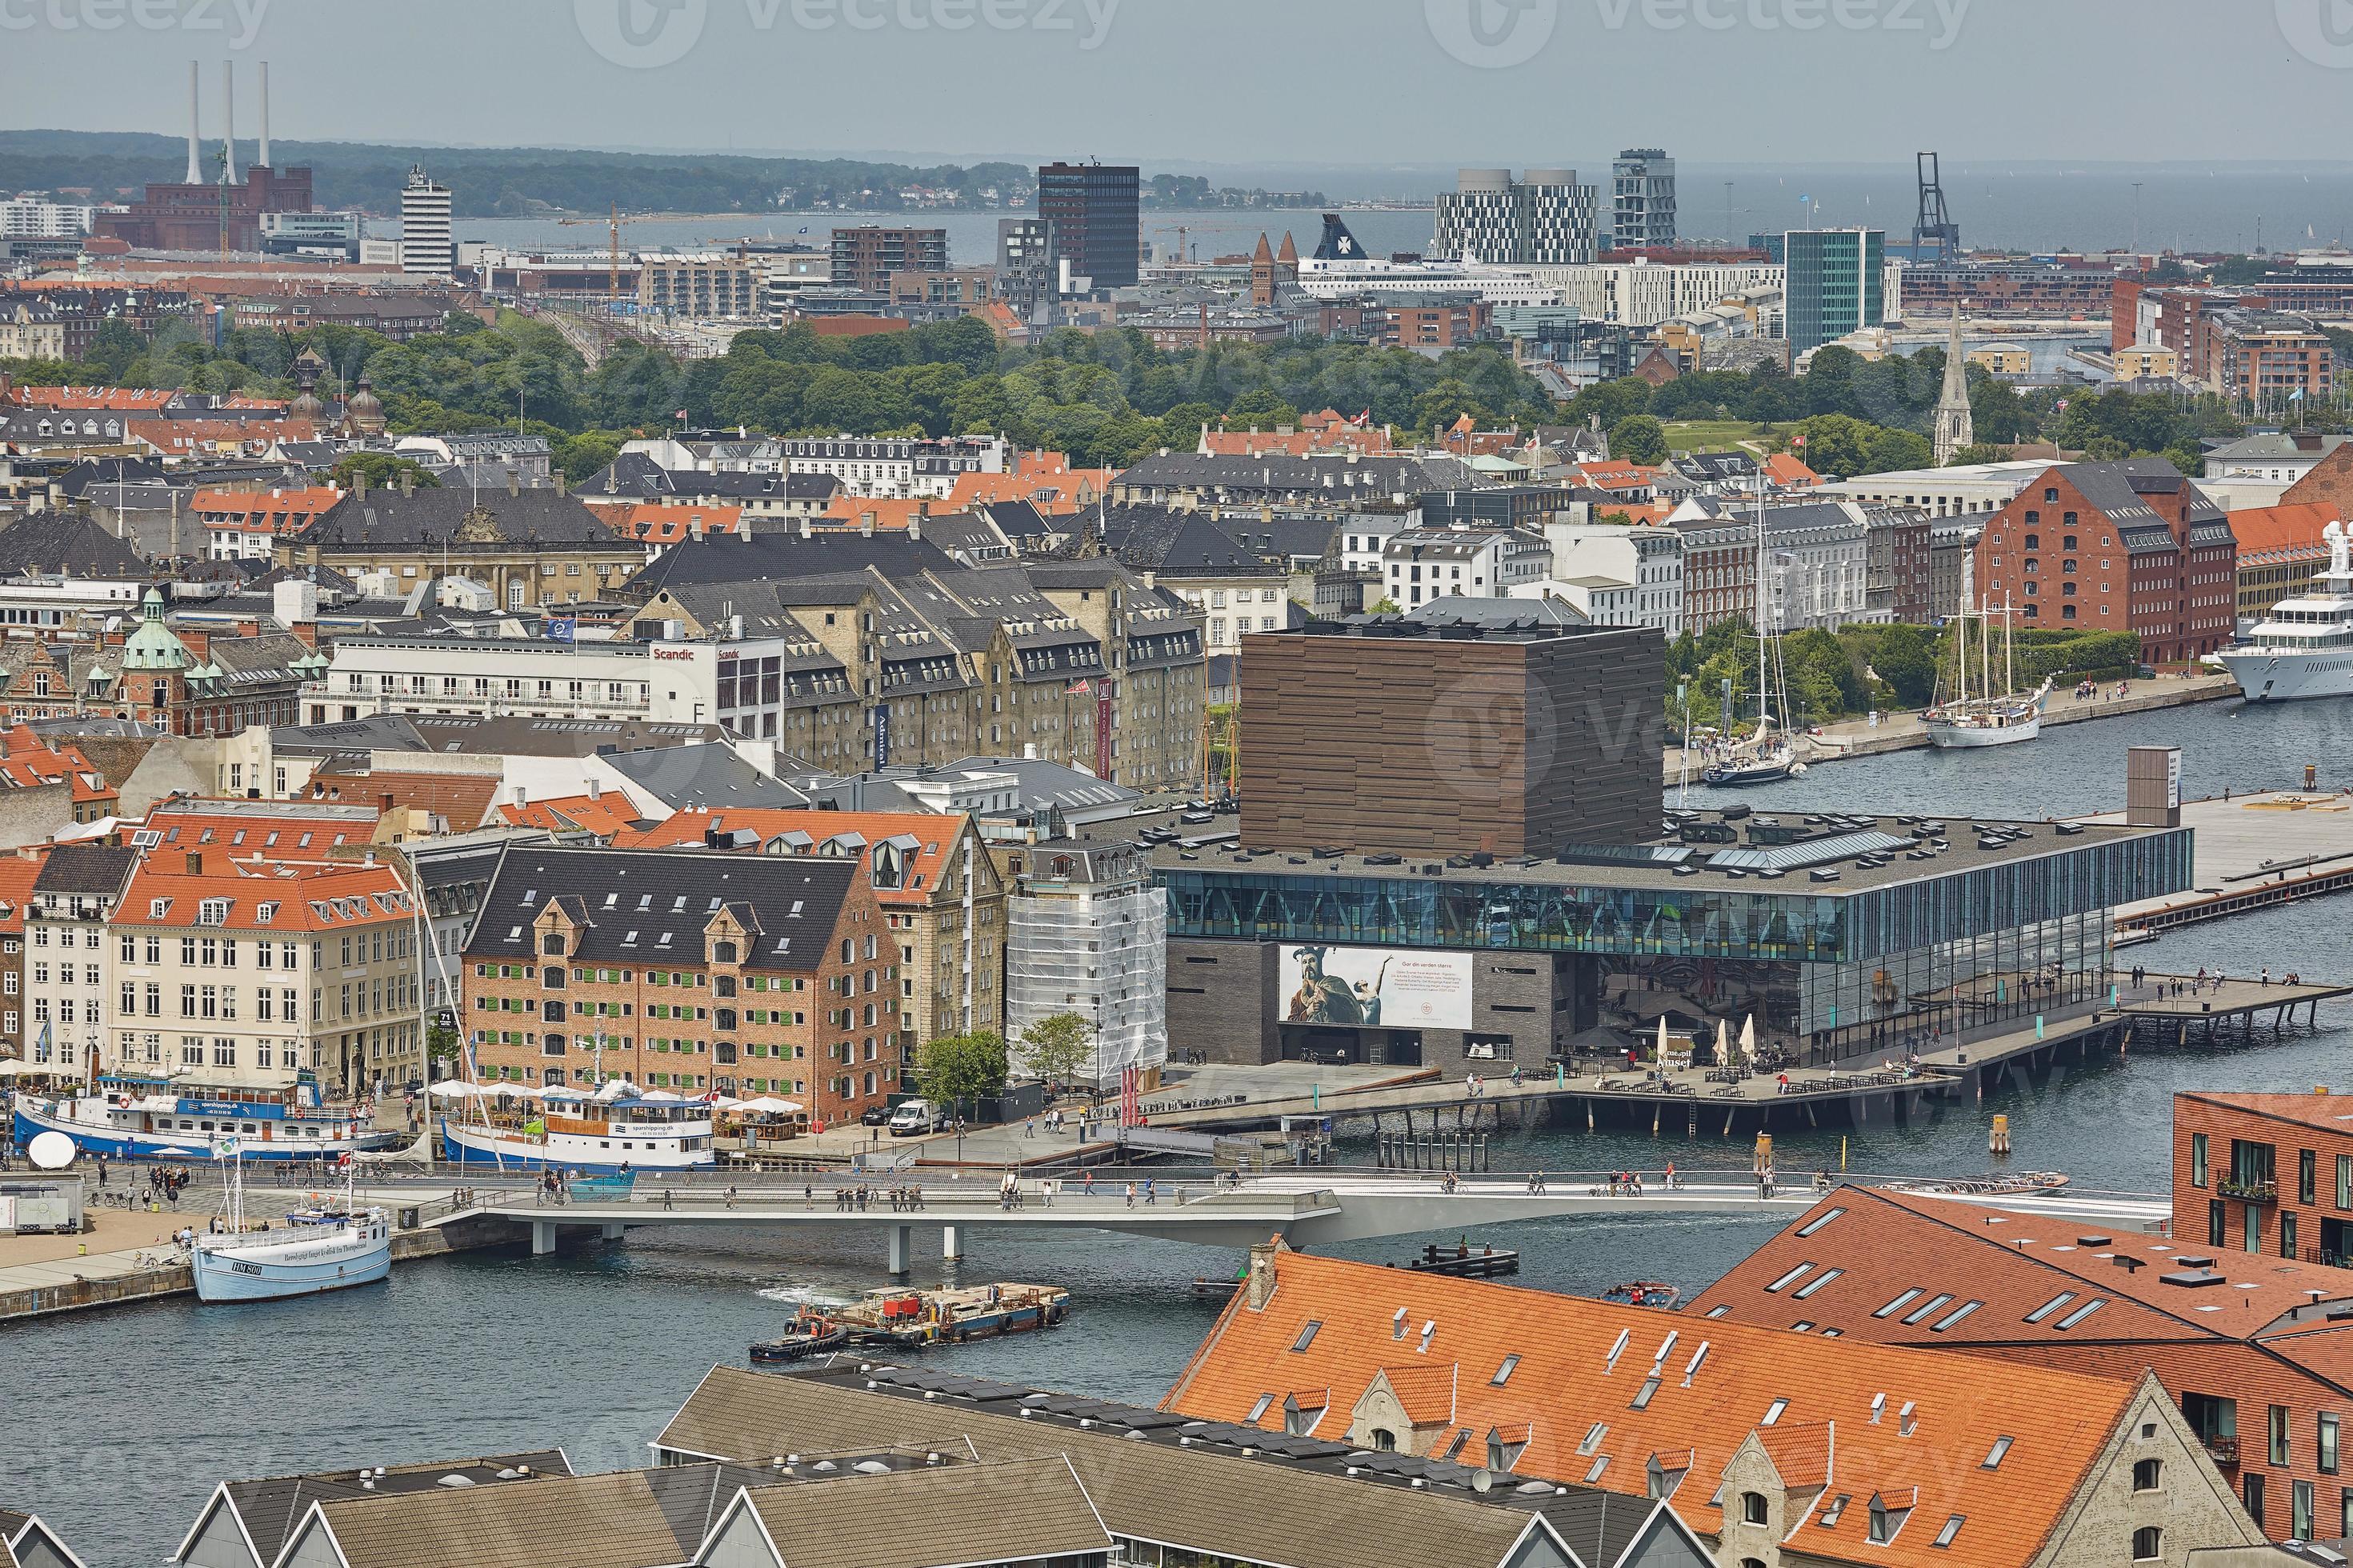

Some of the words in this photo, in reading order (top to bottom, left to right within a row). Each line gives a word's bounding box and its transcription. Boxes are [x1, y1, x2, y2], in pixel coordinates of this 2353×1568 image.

[654, 649, 694, 661] Scandic
[718, 648, 739, 660] Scandic
[1099, 683, 1110, 698] SALT
[233, 1262, 246, 1272] HM
[246, 1266, 261, 1274] 800
